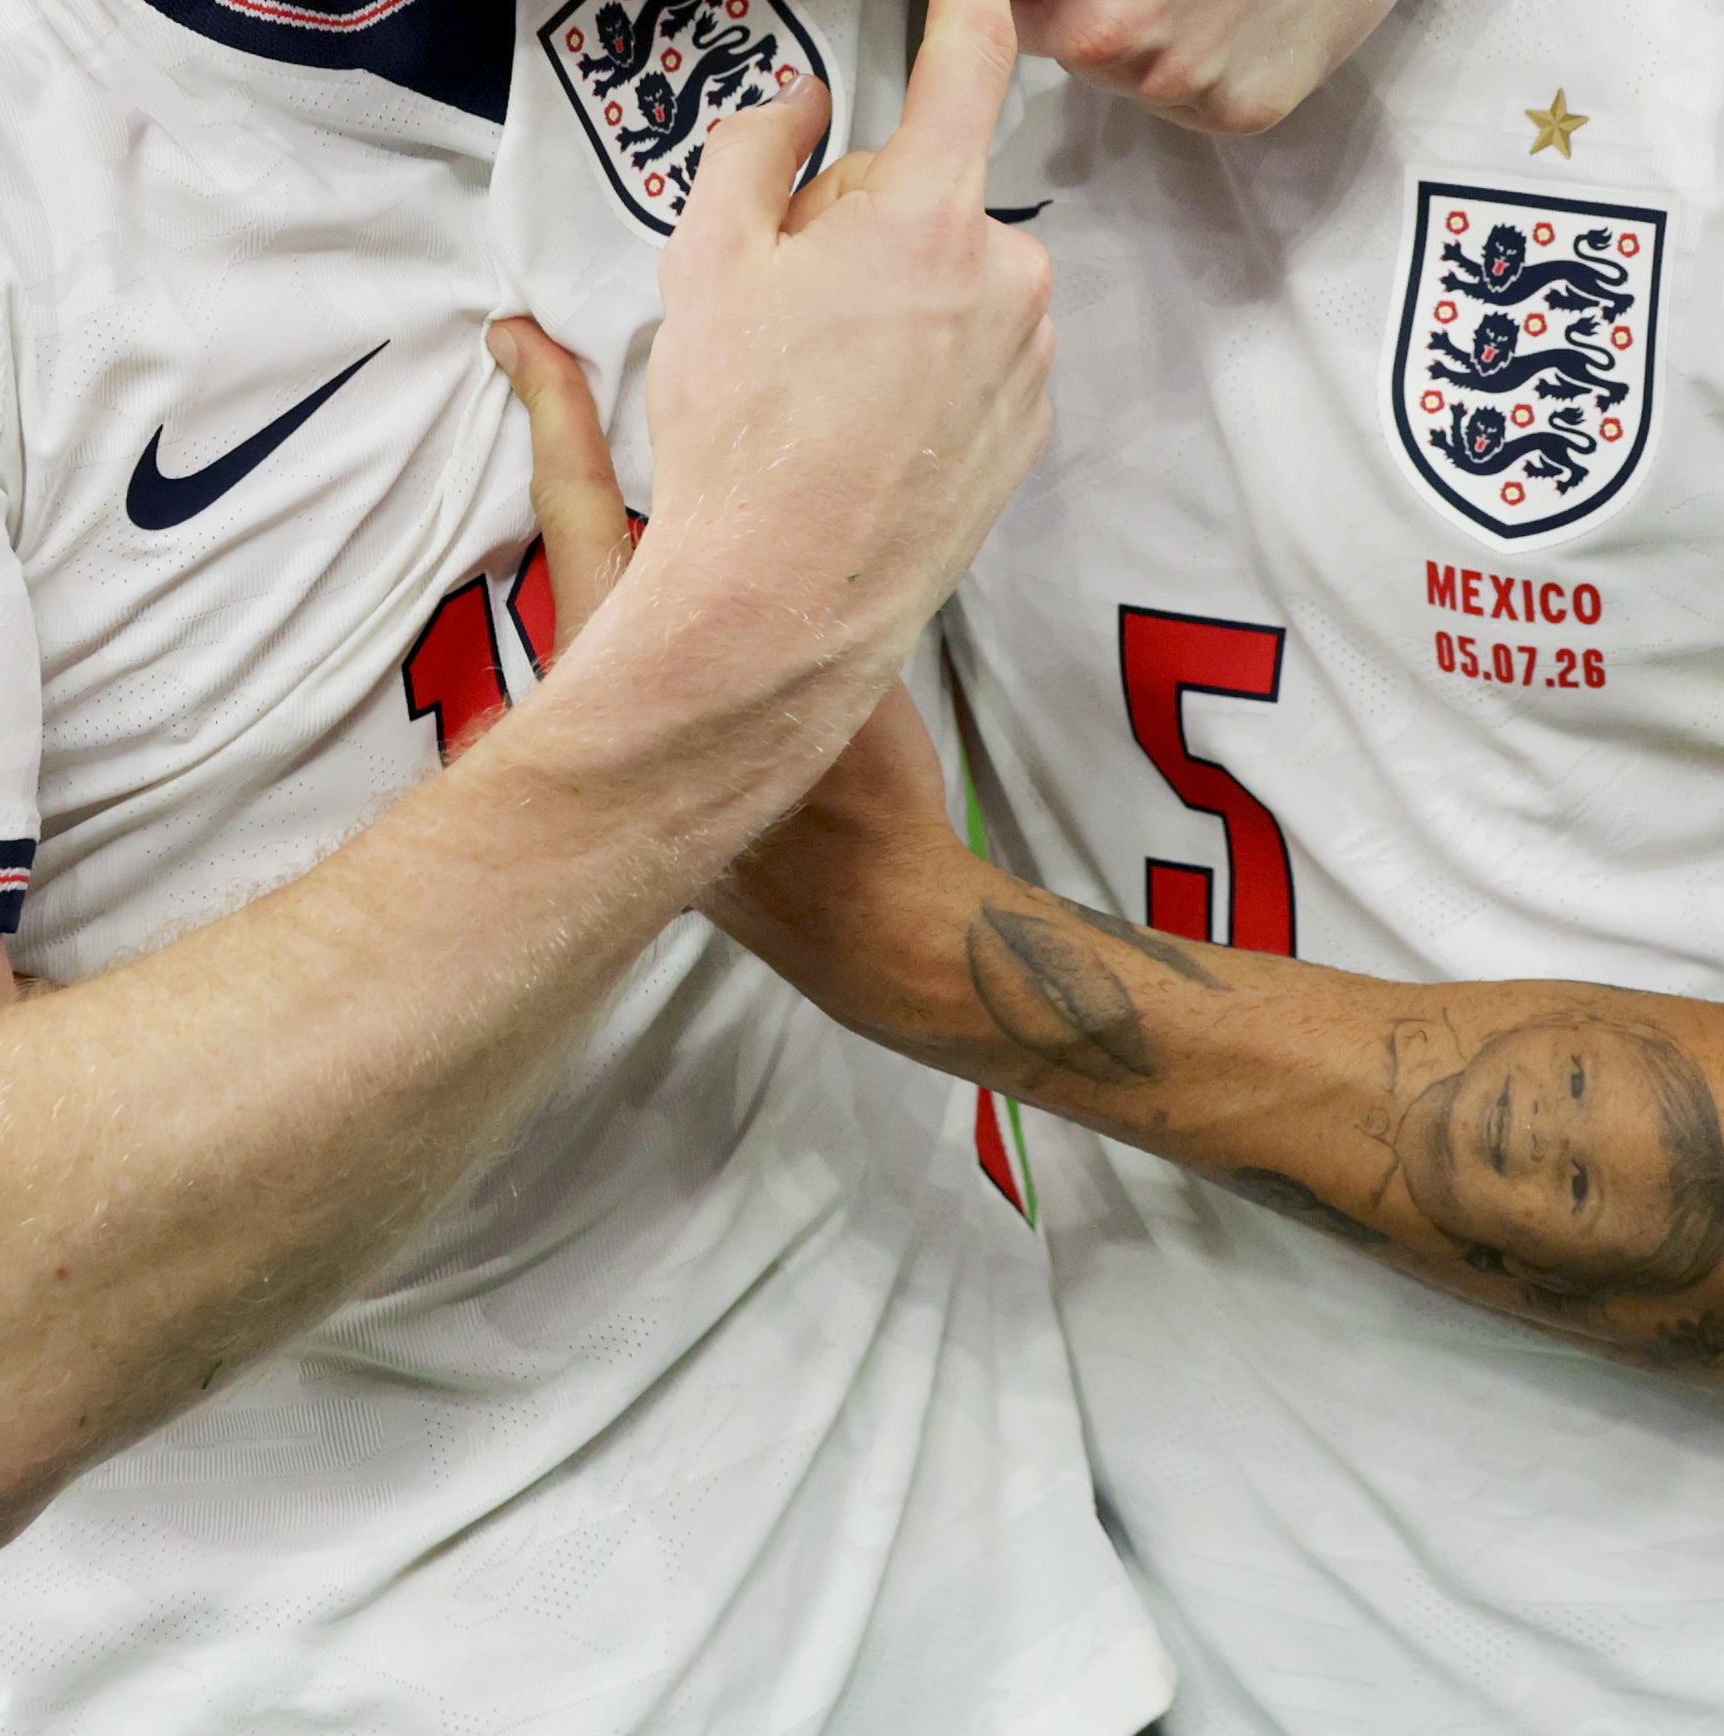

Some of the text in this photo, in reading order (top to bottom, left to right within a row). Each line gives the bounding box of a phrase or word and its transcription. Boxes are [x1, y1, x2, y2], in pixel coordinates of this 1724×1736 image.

[1426, 560, 1602, 625] MEXICO
[1435, 631, 1606, 688] 05.07.26
[1118, 602, 1297, 960] 5
